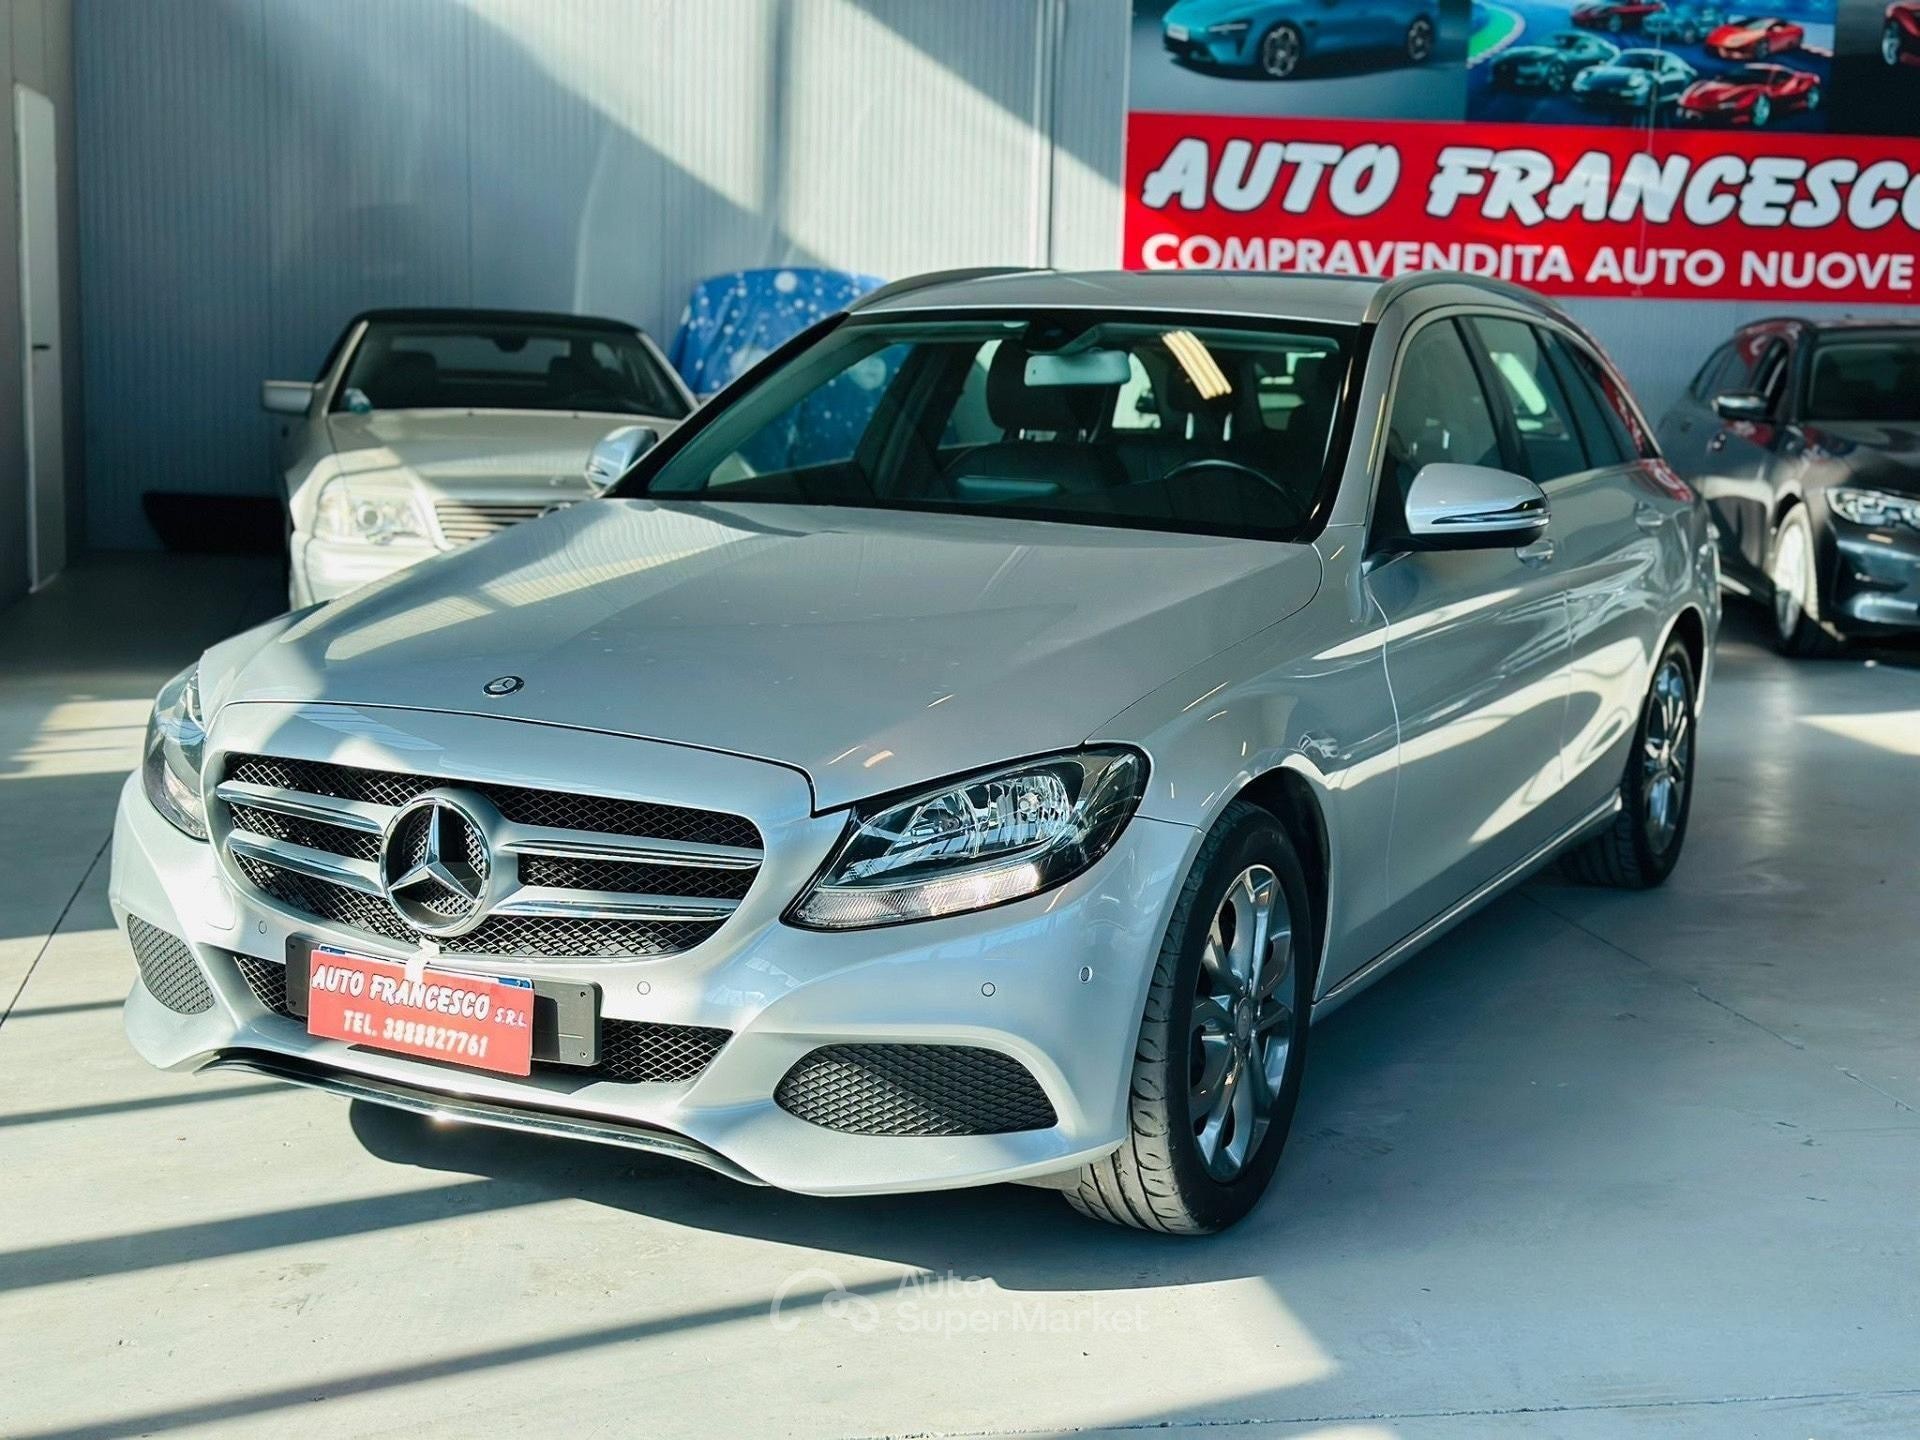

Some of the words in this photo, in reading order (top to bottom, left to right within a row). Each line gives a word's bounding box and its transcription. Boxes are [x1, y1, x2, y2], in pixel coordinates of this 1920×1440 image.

[1142, 137, 1400, 215] AUTO
[1427, 146, 1920, 229] FRANCESC
[1141, 233, 1574, 282] COMPRAVENDITA
[1585, 246, 1726, 287] AUTO
[1740, 250, 1915, 290] NUOVE
[311, 964, 364, 997] AUTO
[370, 973, 490, 1020] FRANCESCO
[343, 1009, 378, 1037] TEL.
